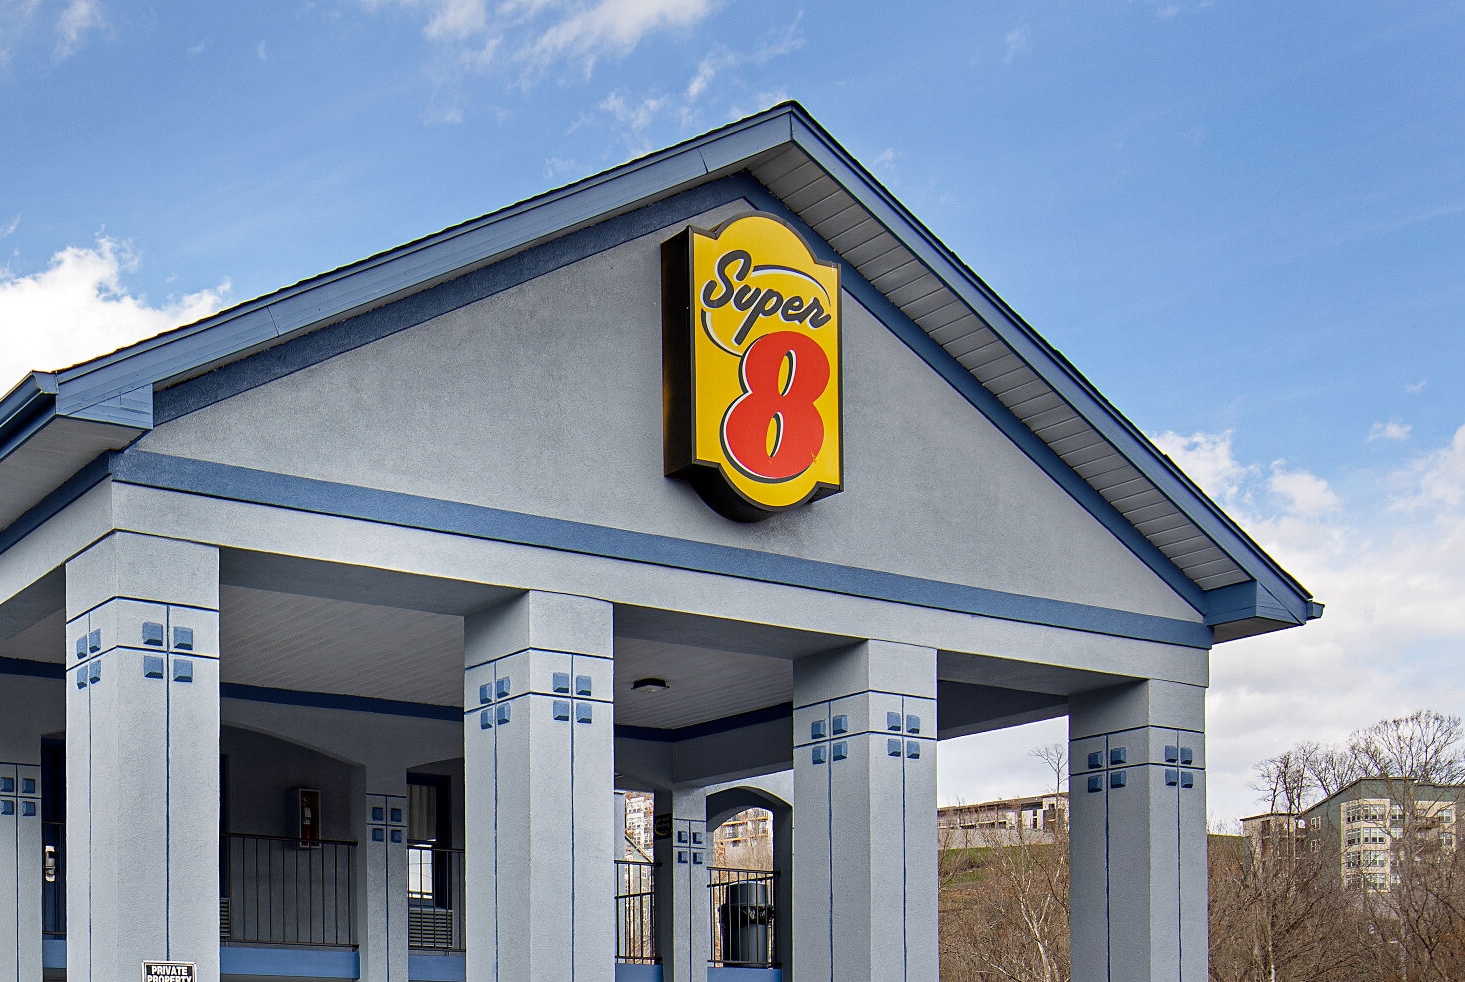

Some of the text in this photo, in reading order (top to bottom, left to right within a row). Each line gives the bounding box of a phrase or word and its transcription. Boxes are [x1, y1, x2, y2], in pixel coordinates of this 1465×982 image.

[701, 249, 833, 346] Super
[719, 330, 832, 484] 8
[151, 965, 188, 976] PRIVATE
